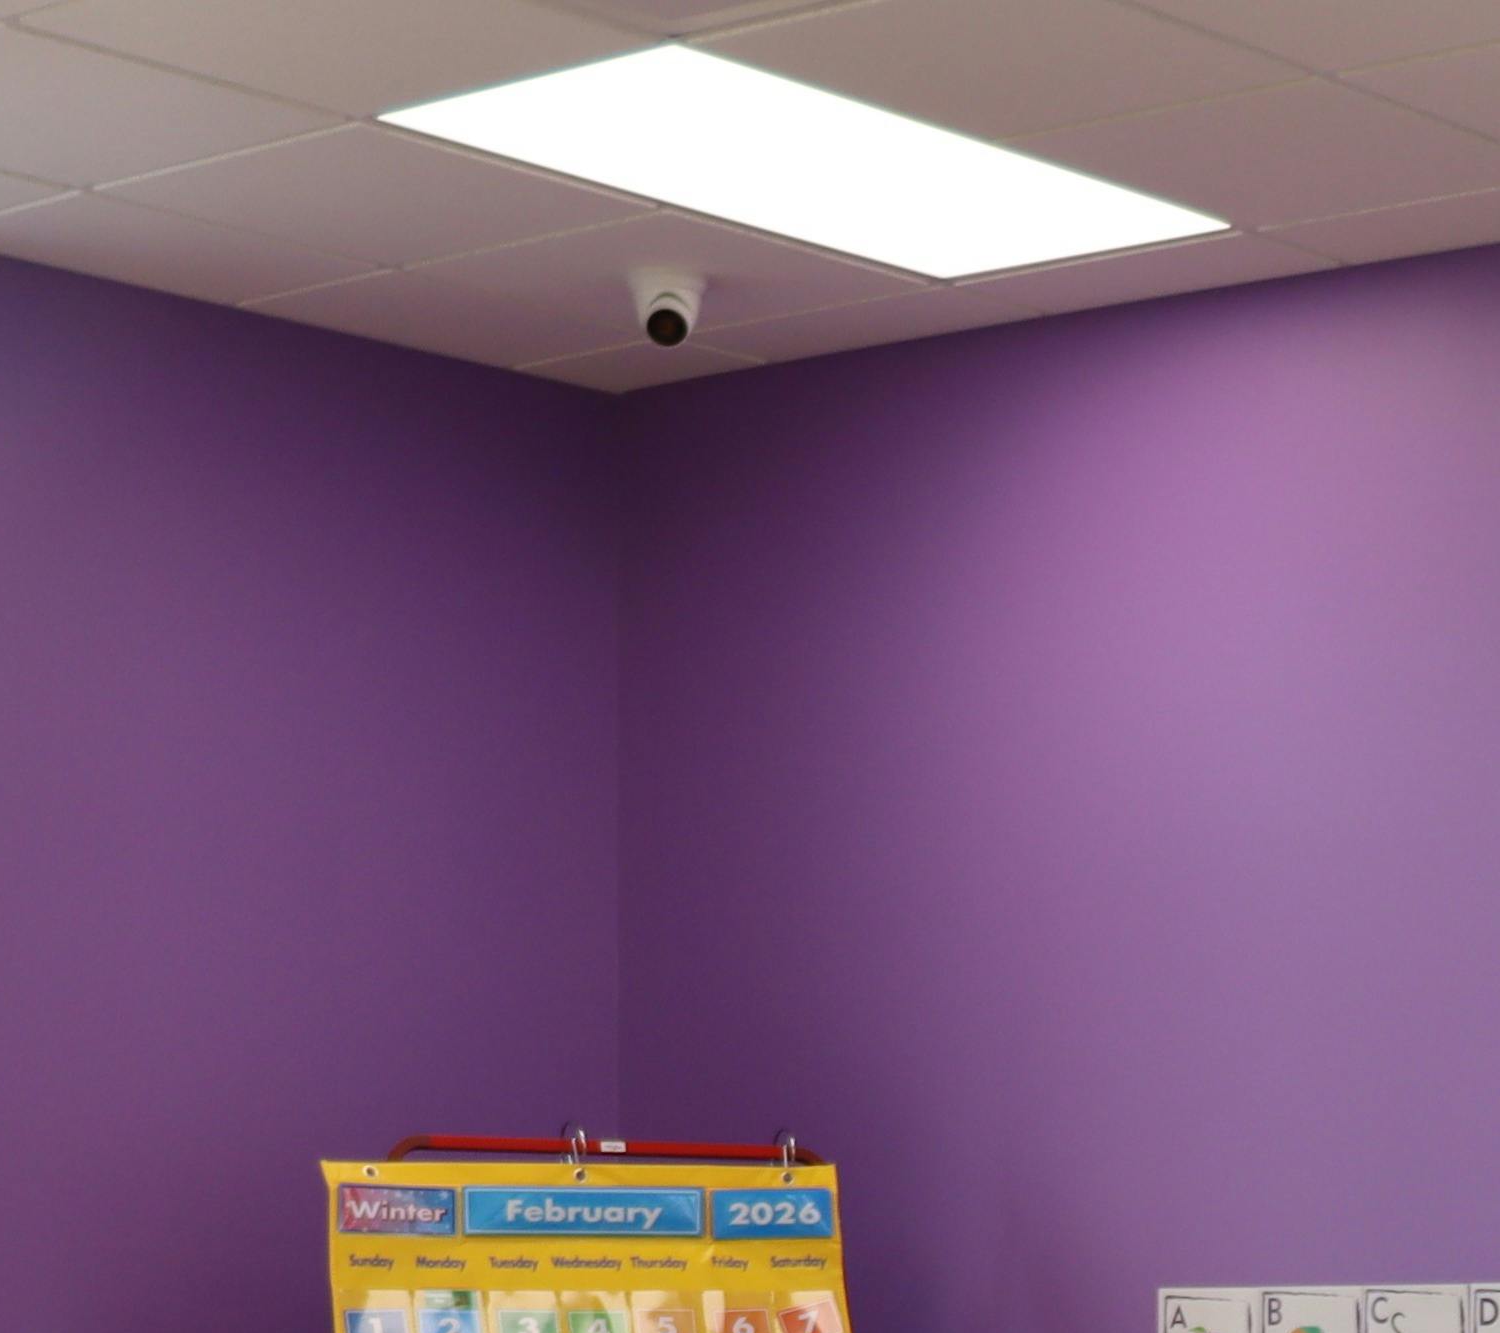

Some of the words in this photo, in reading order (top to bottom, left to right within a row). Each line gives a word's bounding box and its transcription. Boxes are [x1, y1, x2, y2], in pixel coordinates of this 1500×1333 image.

[349, 1198, 447, 1223] Winter
[506, 1198, 663, 1230] February
[728, 1202, 821, 1226] 2026
[348, 1254, 395, 1270] Sunday
[416, 1256, 467, 1271] Monday
[489, 1256, 538, 1271] Tuesday
[551, 1256, 622, 1271] Wednesday
[631, 1256, 688, 1271] Thursday
[711, 1256, 749, 1271] Friday
[770, 1255, 827, 1269] Saturday
[1170, 1306, 1186, 1328] A
[1268, 1298, 1282, 1325] B
[1371, 1297, 1388, 1324] C
[1480, 1298, 1499, 1326] D
